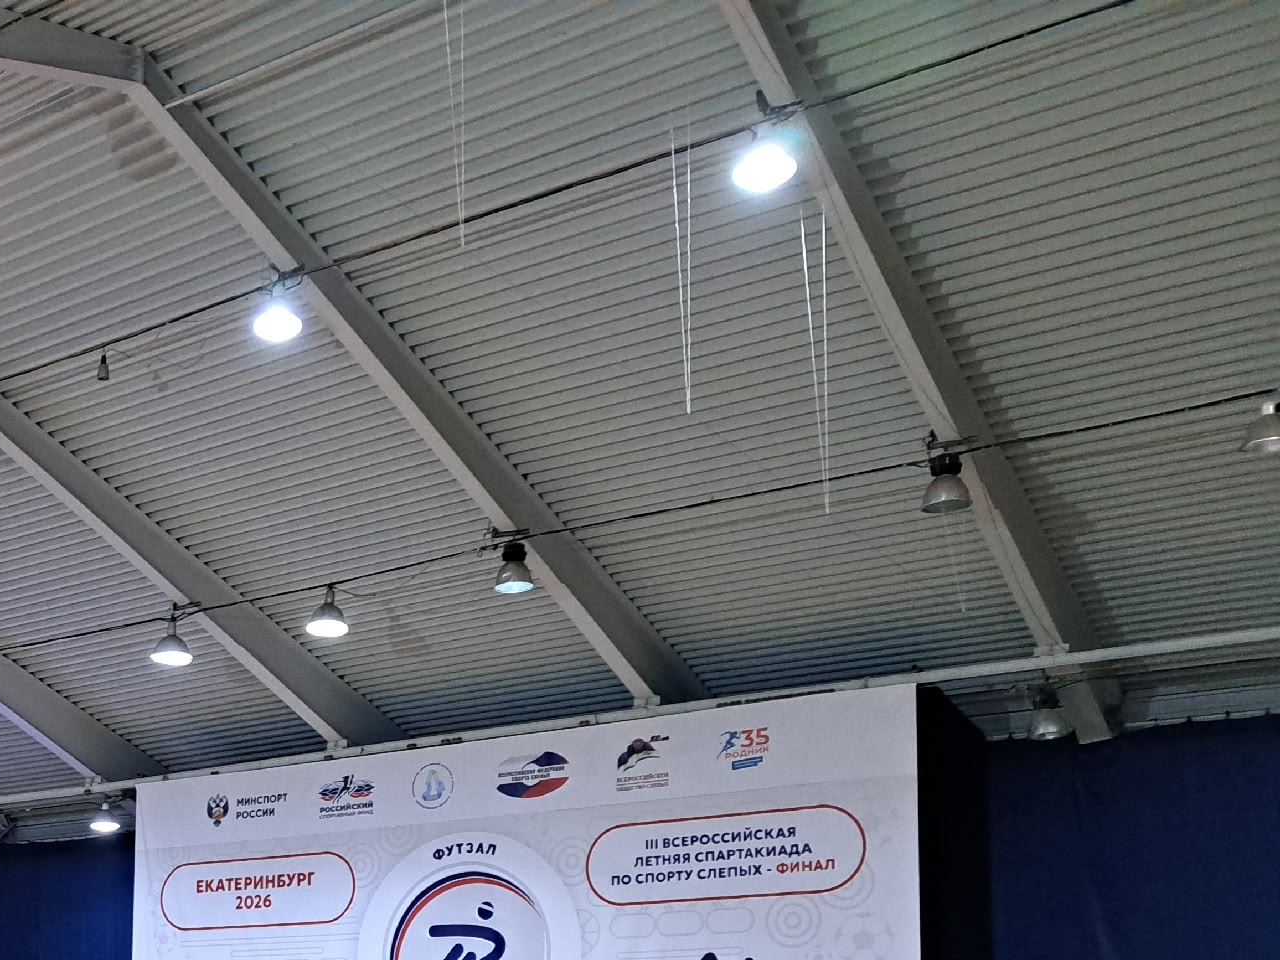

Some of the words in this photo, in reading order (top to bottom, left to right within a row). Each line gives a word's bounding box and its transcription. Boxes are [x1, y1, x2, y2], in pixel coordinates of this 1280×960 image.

[739, 726, 770, 748] 35
[724, 746, 770, 760] РОДНИК
[236, 792, 288, 807] МИНСПОРТ
[319, 800, 374, 813] РОССИЙСКИЙ
[236, 807, 275, 819] РОССИИ
[645, 839, 658, 850] III
[663, 826, 796, 849] ВСЕРОССИЙСКАЯ
[432, 842, 497, 861] ФУТЗАЛ
[634, 853, 691, 868] ЛЕТНЯЯ
[694, 842, 813, 863] СПАРТАКИАДА
[611, 874, 631, 886] ПО
[635, 870, 692, 884] СПОРТУ
[697, 864, 763, 880] СЛЕПЫХ
[776, 858, 835, 875] ФИНАЛ
[196, 872, 315, 893] ЕКАТЕРИНБУРГ
[235, 894, 272, 910] 2026
